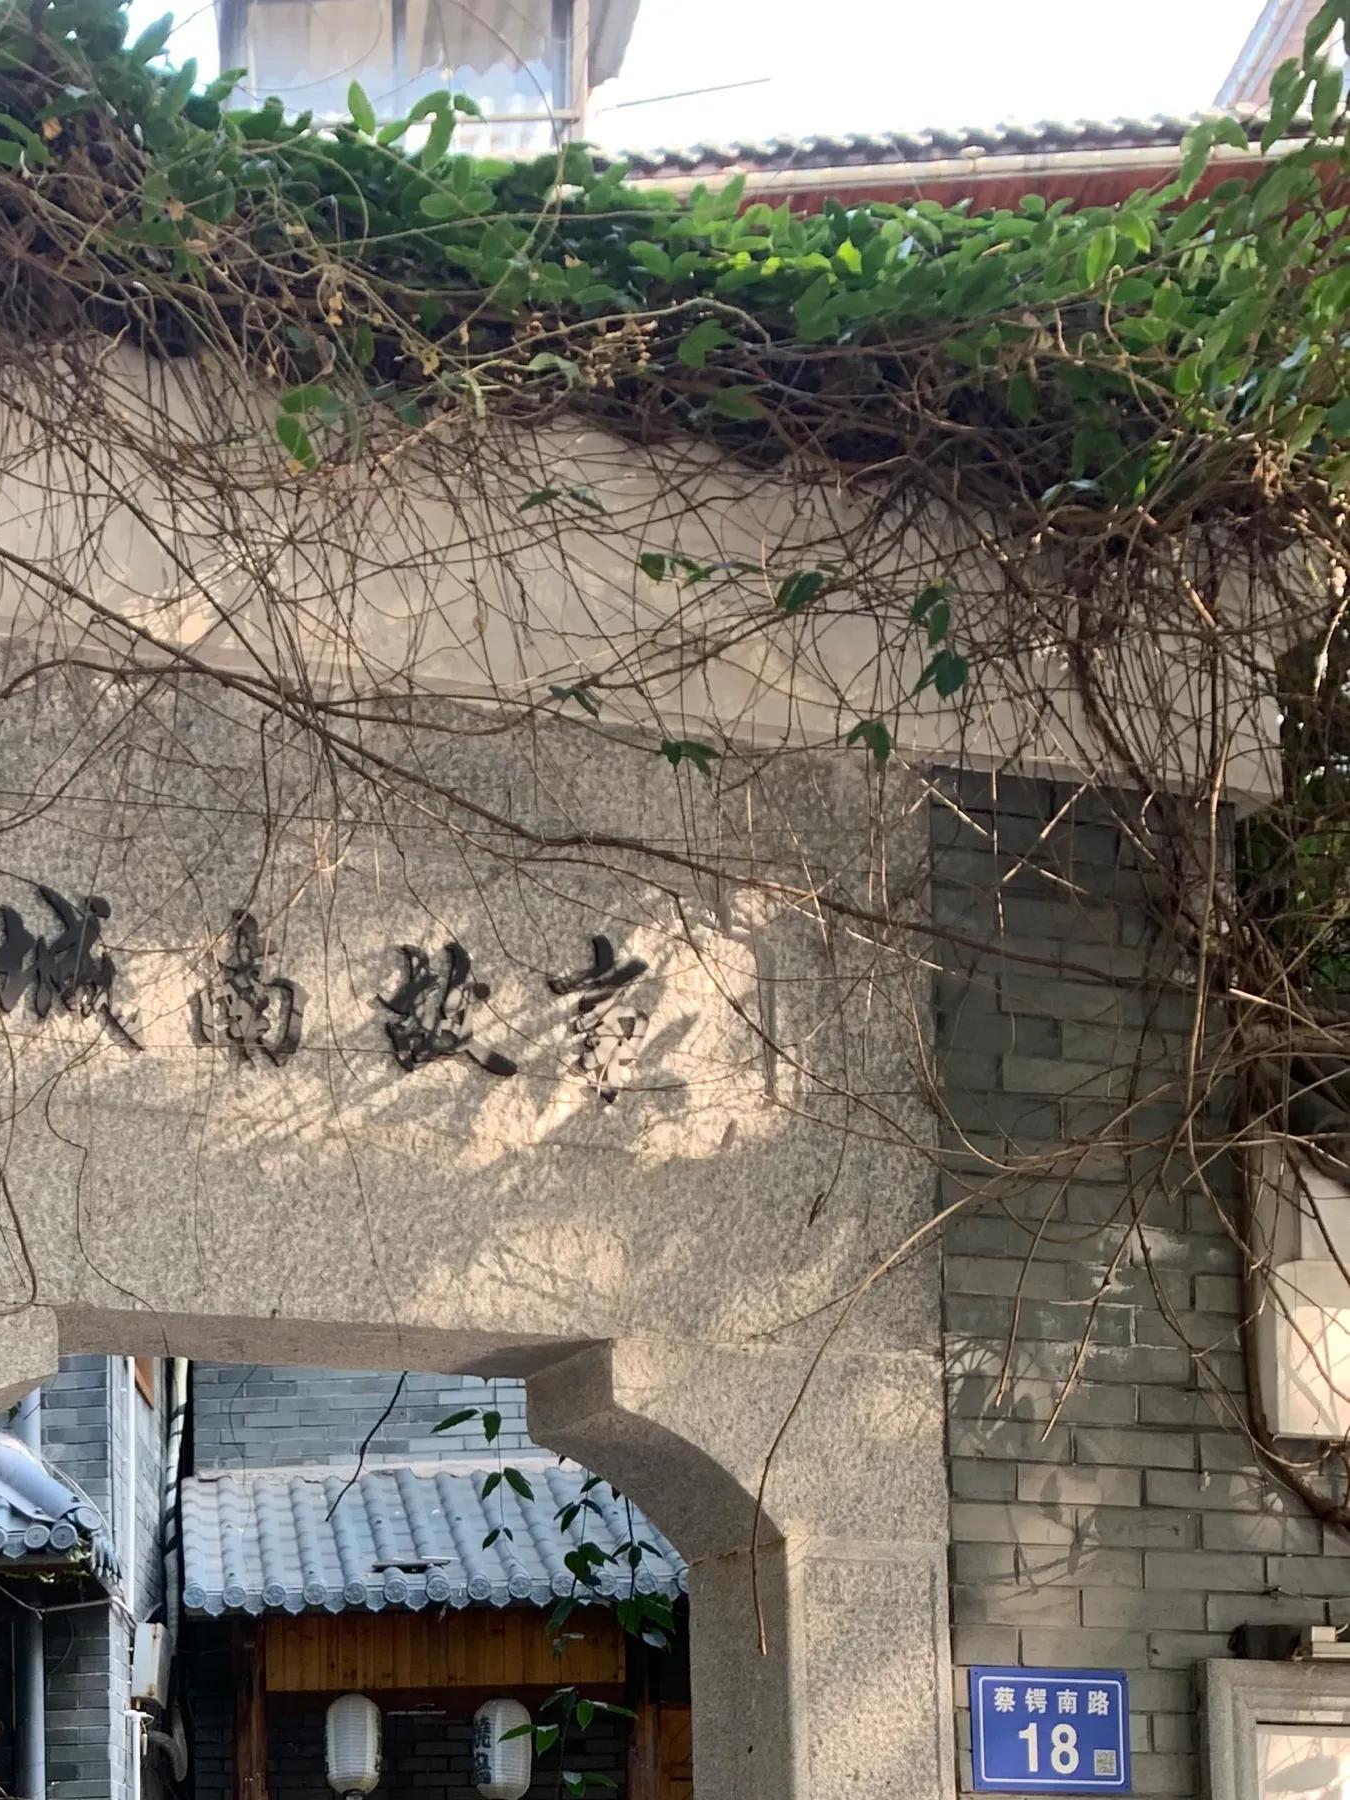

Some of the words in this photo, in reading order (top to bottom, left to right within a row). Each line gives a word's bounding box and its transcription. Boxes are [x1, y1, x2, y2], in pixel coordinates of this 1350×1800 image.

[994, 1687, 1110, 1715] 蔡锷南路
[1018, 1722, 1080, 1775] 18
